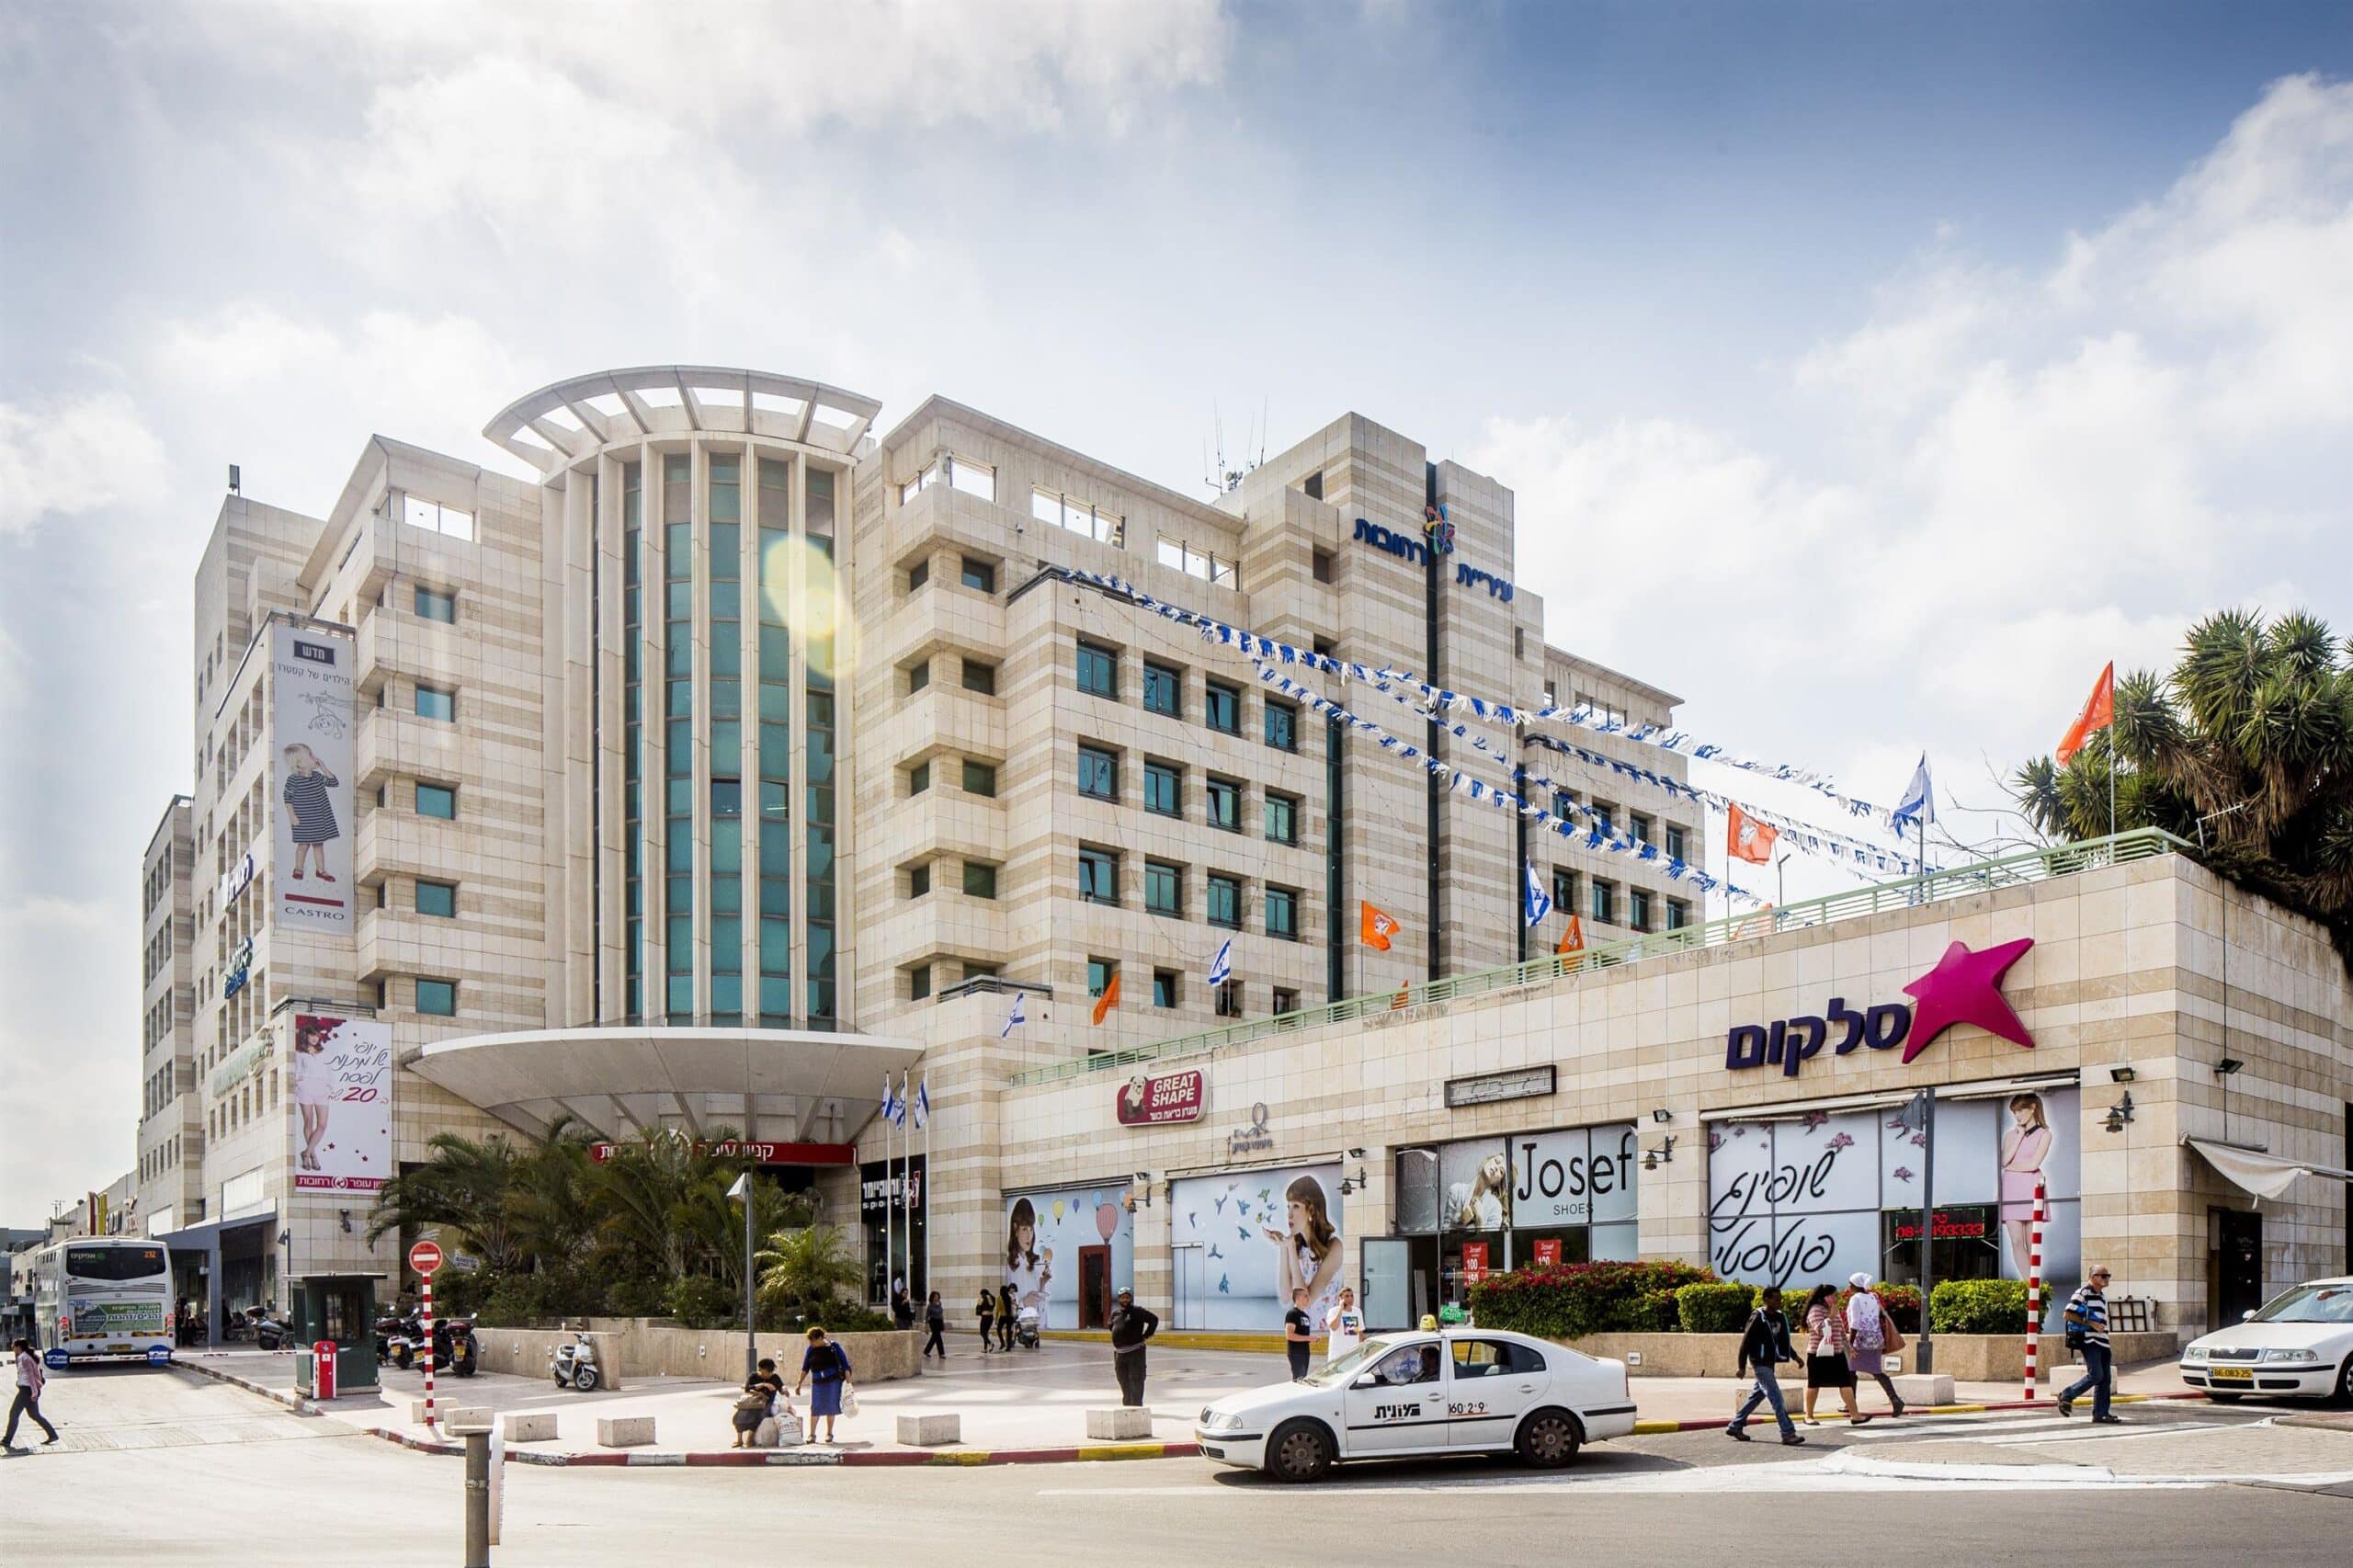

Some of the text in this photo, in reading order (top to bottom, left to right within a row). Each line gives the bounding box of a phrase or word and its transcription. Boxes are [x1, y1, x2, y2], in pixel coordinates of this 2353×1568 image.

[1354, 517, 1428, 567] רחובות
[302, 645, 324, 660] חדש
[278, 663, 350, 687] הילדים של קסטרו
[285, 906, 345, 921] CASTRO
[1725, 997, 1913, 1077] סלקום
[371, 1048, 390, 1066] של
[339, 1067, 390, 1085] לפסח
[1154, 1073, 1197, 1093] GREAT
[1152, 1087, 1195, 1108] SHAPE
[1518, 1131, 1632, 1200] Josef
[863, 1198, 901, 1210] spot
[1553, 1203, 1594, 1216] SHOES
[1715, 1218, 1836, 1289] פנטסטי
[1466, 1258, 1478, 1270] 100
